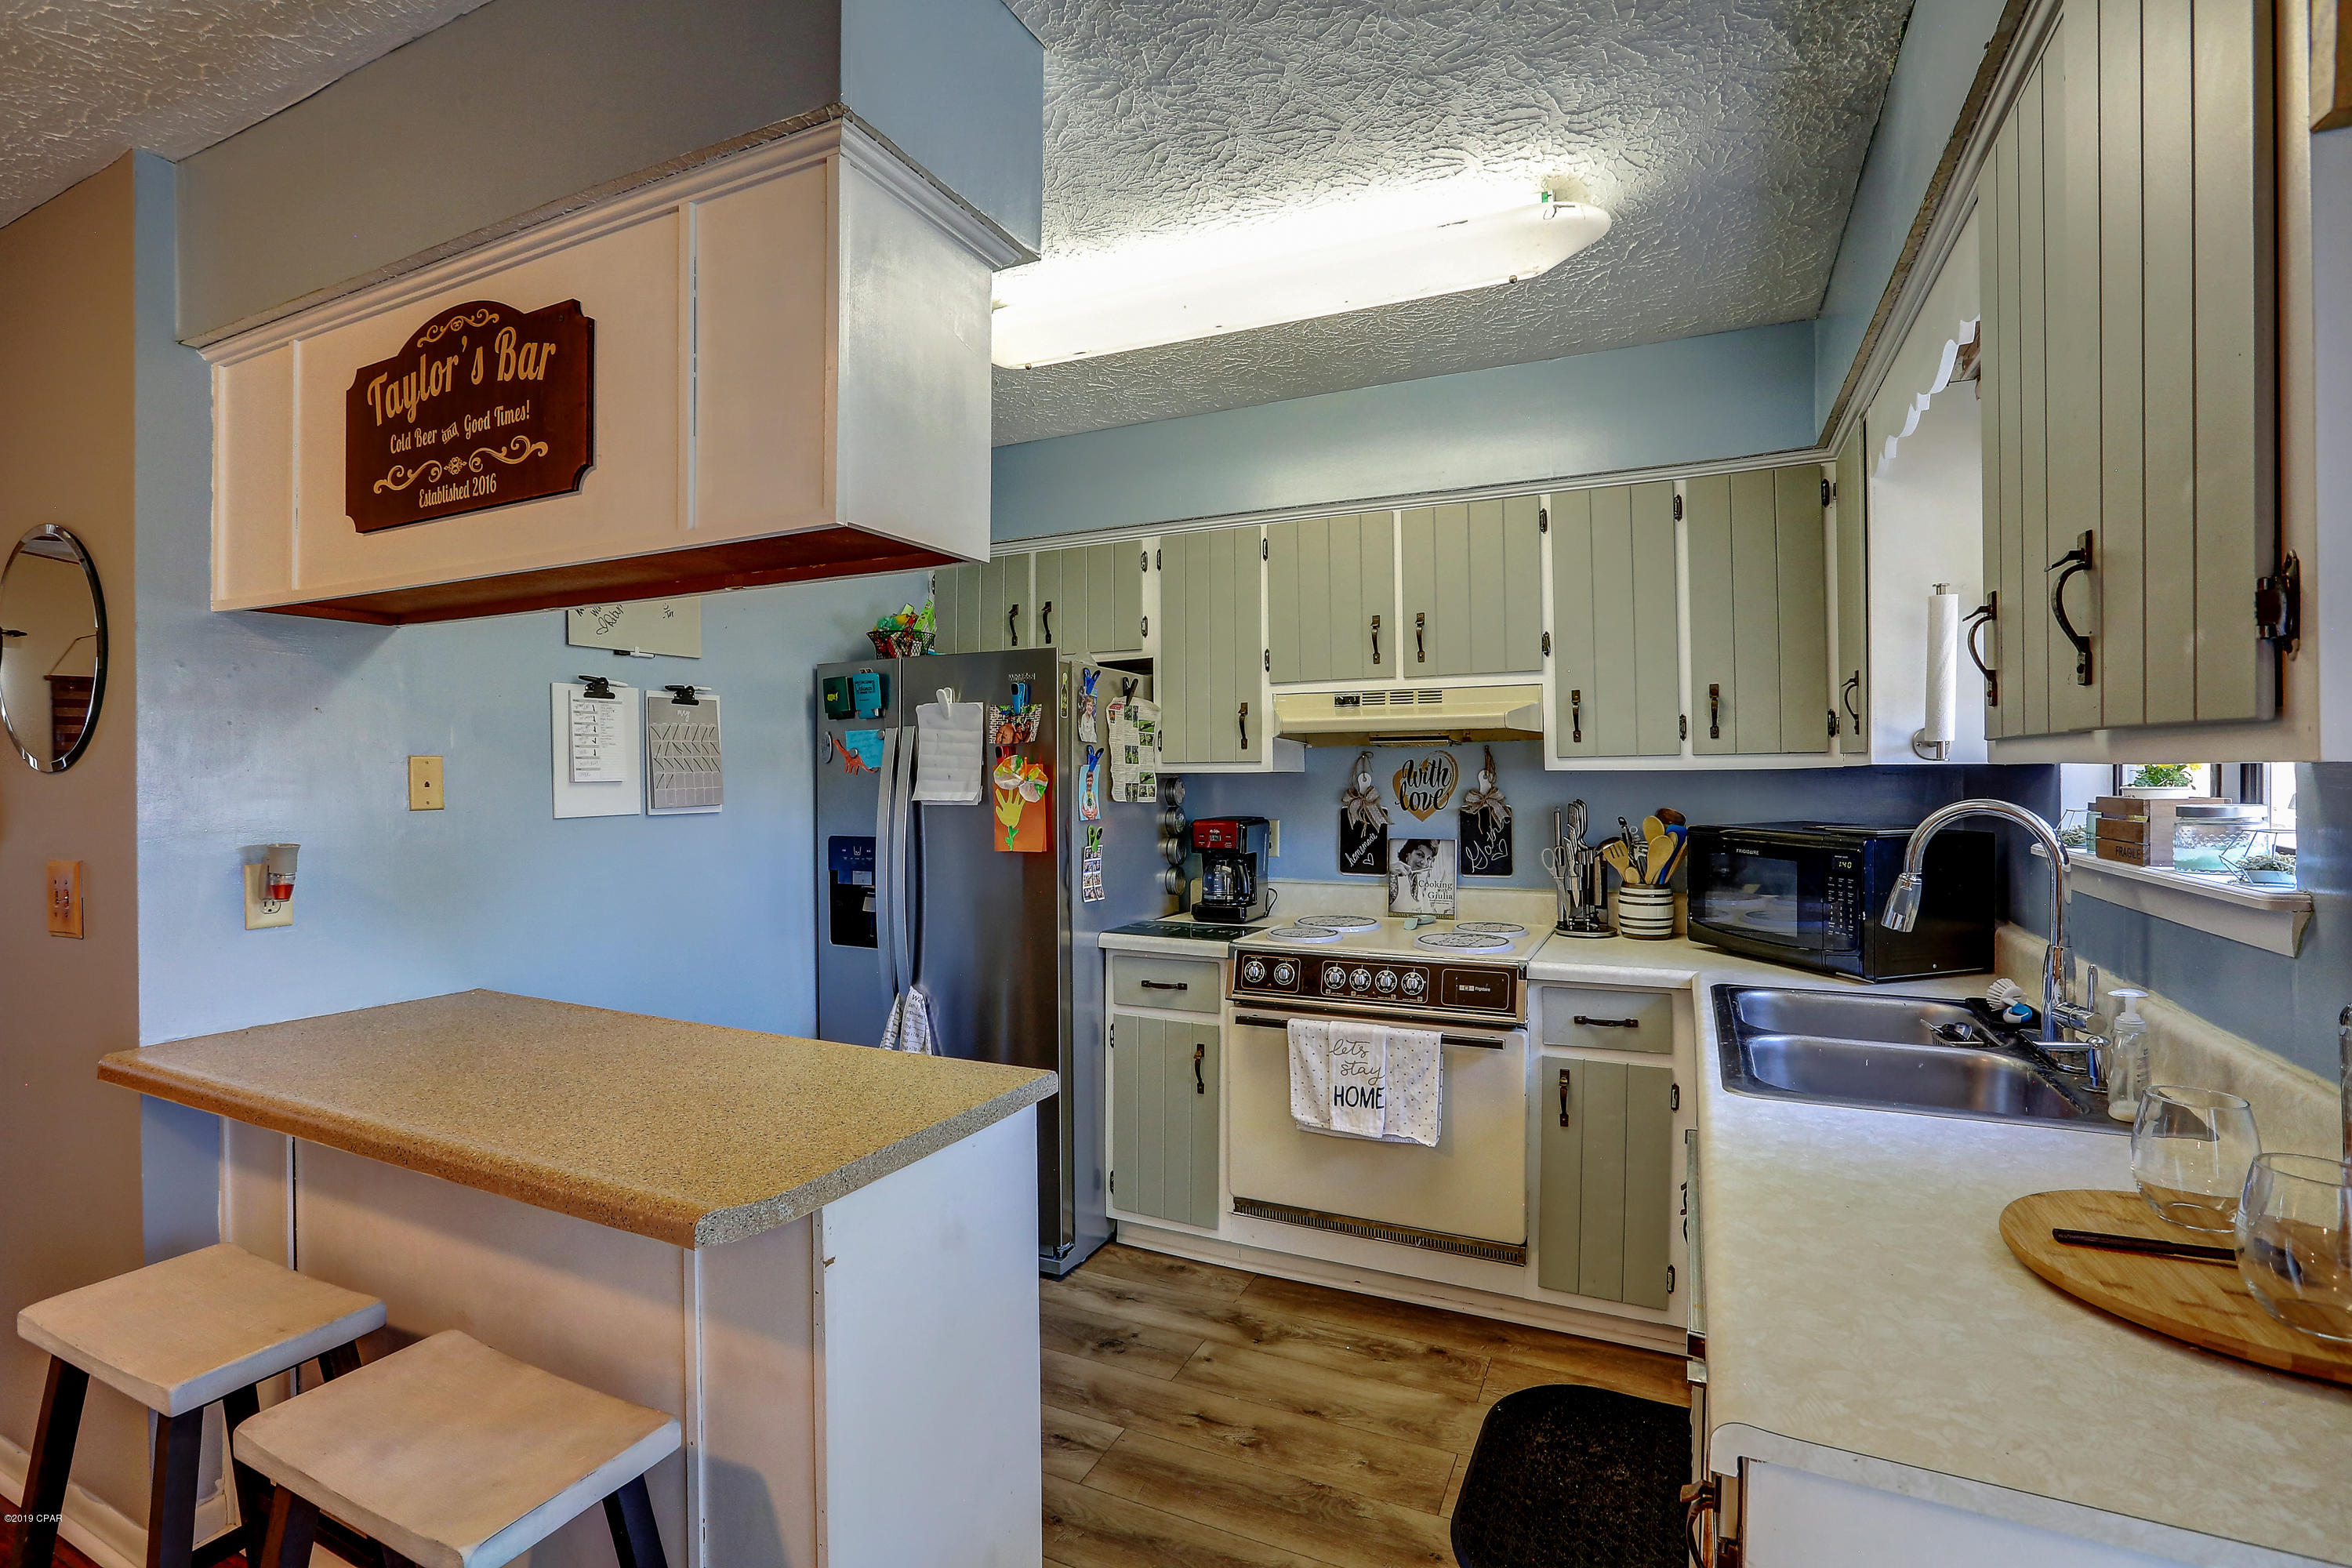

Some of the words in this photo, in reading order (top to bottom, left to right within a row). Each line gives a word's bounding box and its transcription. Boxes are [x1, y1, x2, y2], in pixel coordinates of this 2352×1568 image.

[367, 336, 484, 426] Taylor's
[495, 326, 556, 382] Bar
[390, 431, 412, 454] Cold
[414, 427, 437, 448] Beer
[441, 422, 459, 445] and
[464, 410, 491, 440] Good
[494, 400, 530, 426] Times!
[419, 480, 470, 508] Established
[472, 473, 497, 496] 2016
[1403, 757, 1451, 788] with
[1395, 782, 1450, 811] love
[1345, 833, 1378, 868] homemade
[2115, 845, 2141, 860] FRAGILE
[1418, 880, 1453, 891] Cooking
[1428, 891, 1453, 900] Giulia
[1341, 1060, 1385, 1086] stay
[1334, 1085, 1385, 1109] HOME
